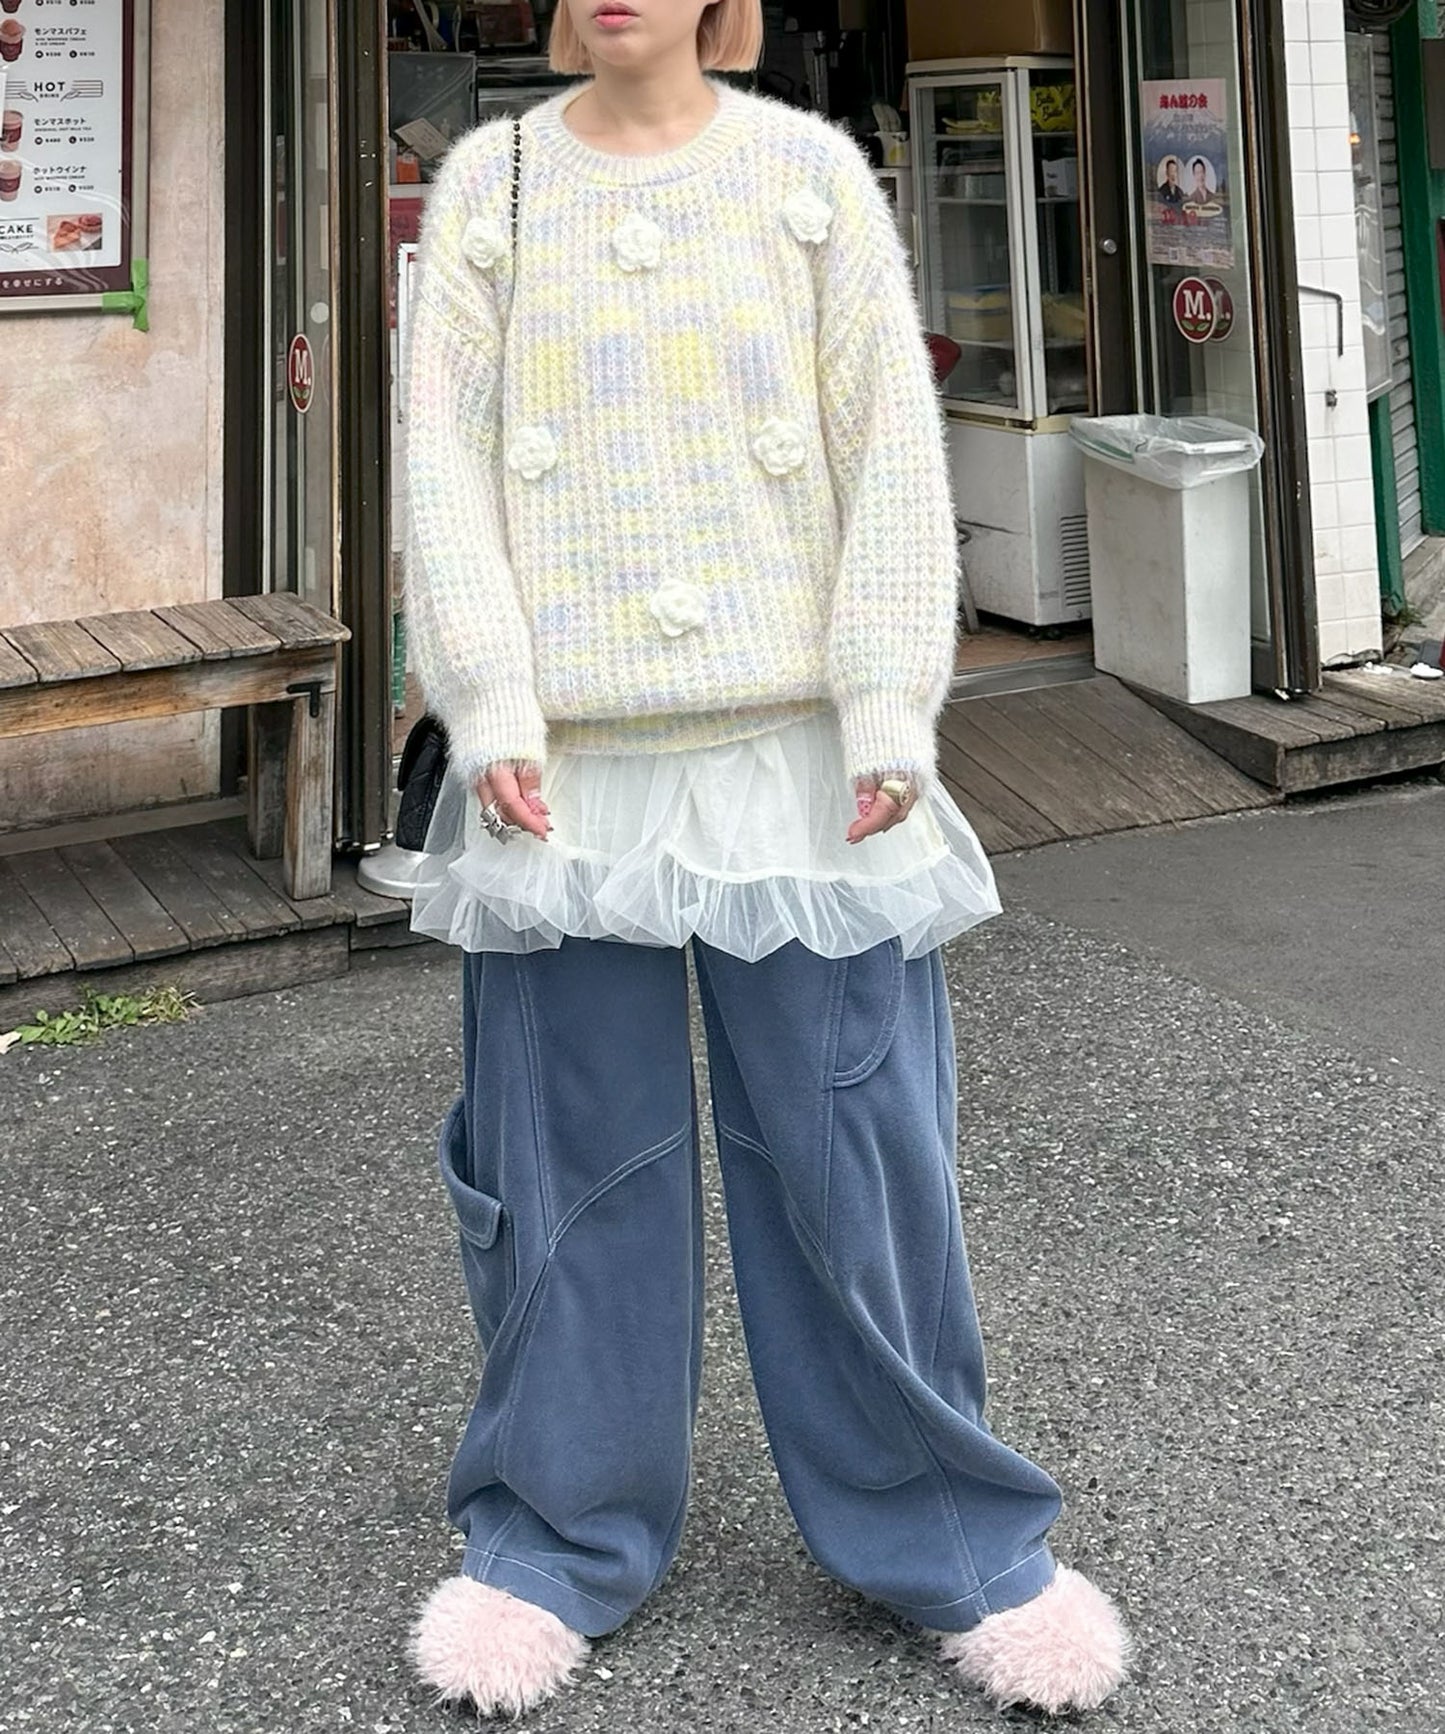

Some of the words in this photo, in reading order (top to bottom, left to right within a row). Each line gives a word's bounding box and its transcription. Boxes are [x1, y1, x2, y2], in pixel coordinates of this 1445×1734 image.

[34, 81, 66, 92] HOT
[34, 118, 86, 126] モンマスホット
